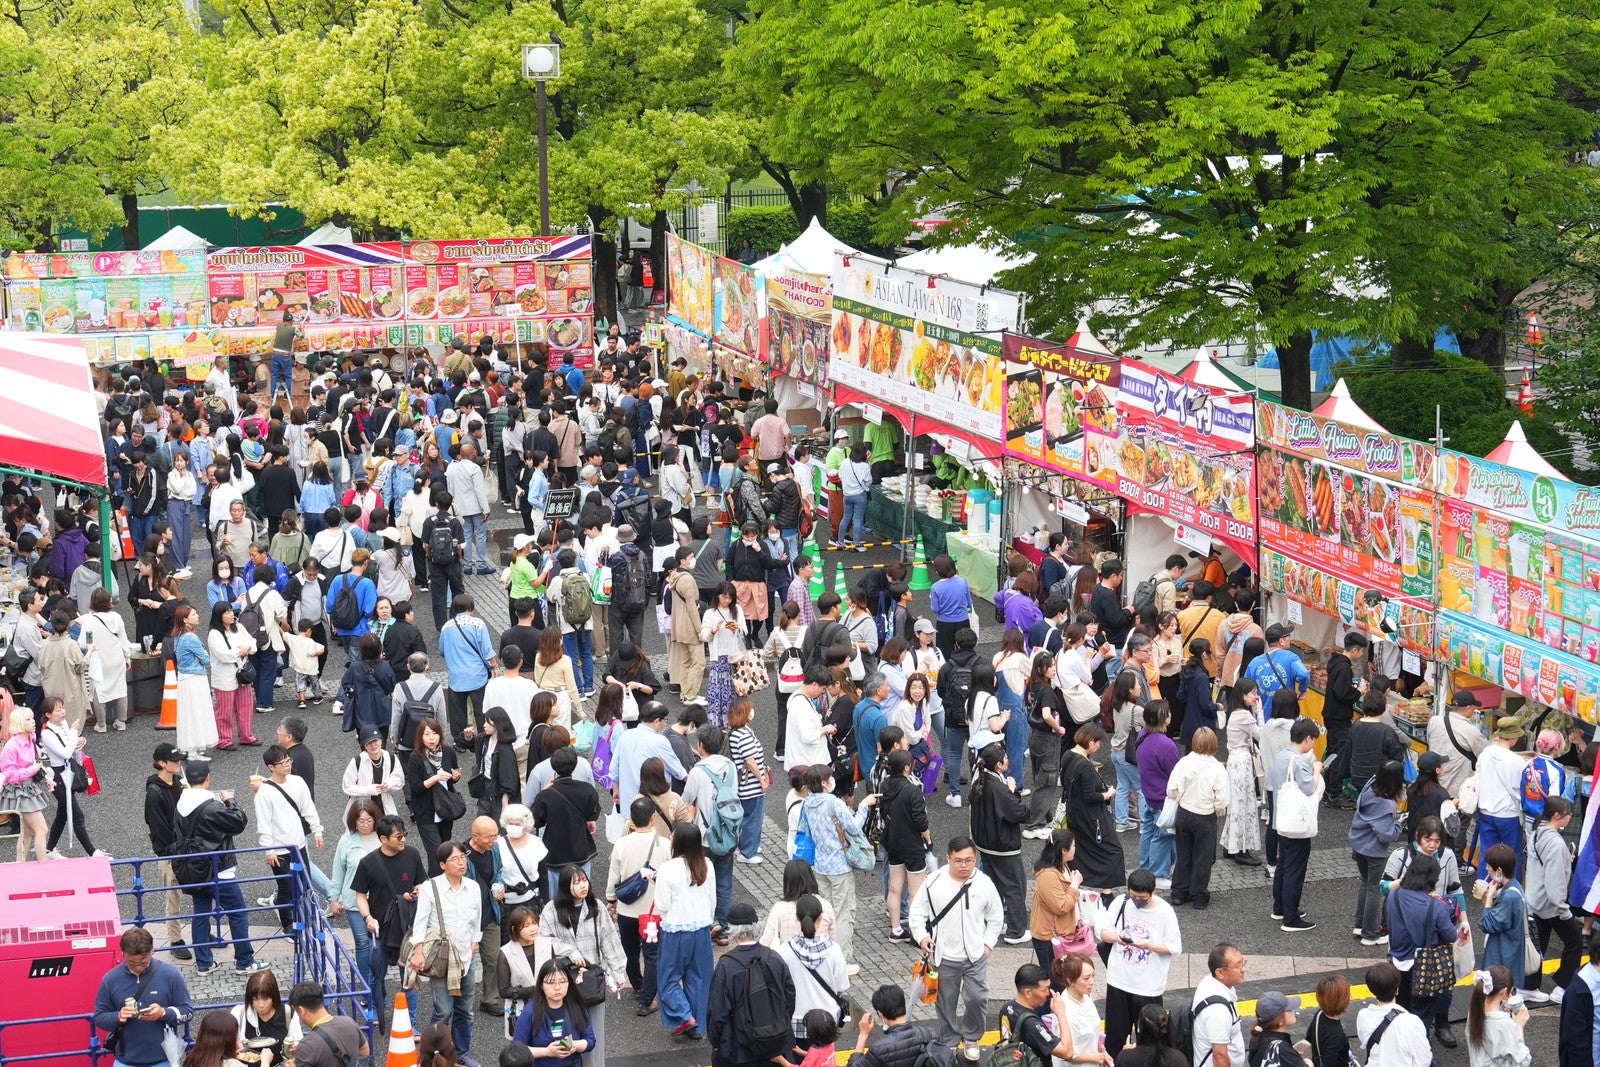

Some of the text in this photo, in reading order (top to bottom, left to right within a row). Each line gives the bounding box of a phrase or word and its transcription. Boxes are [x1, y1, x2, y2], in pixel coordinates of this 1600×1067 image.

[99, 257, 110, 270] P
[1288, 413, 1395, 463] Little Asian Food
[31, 965, 68, 977] AKTIO
